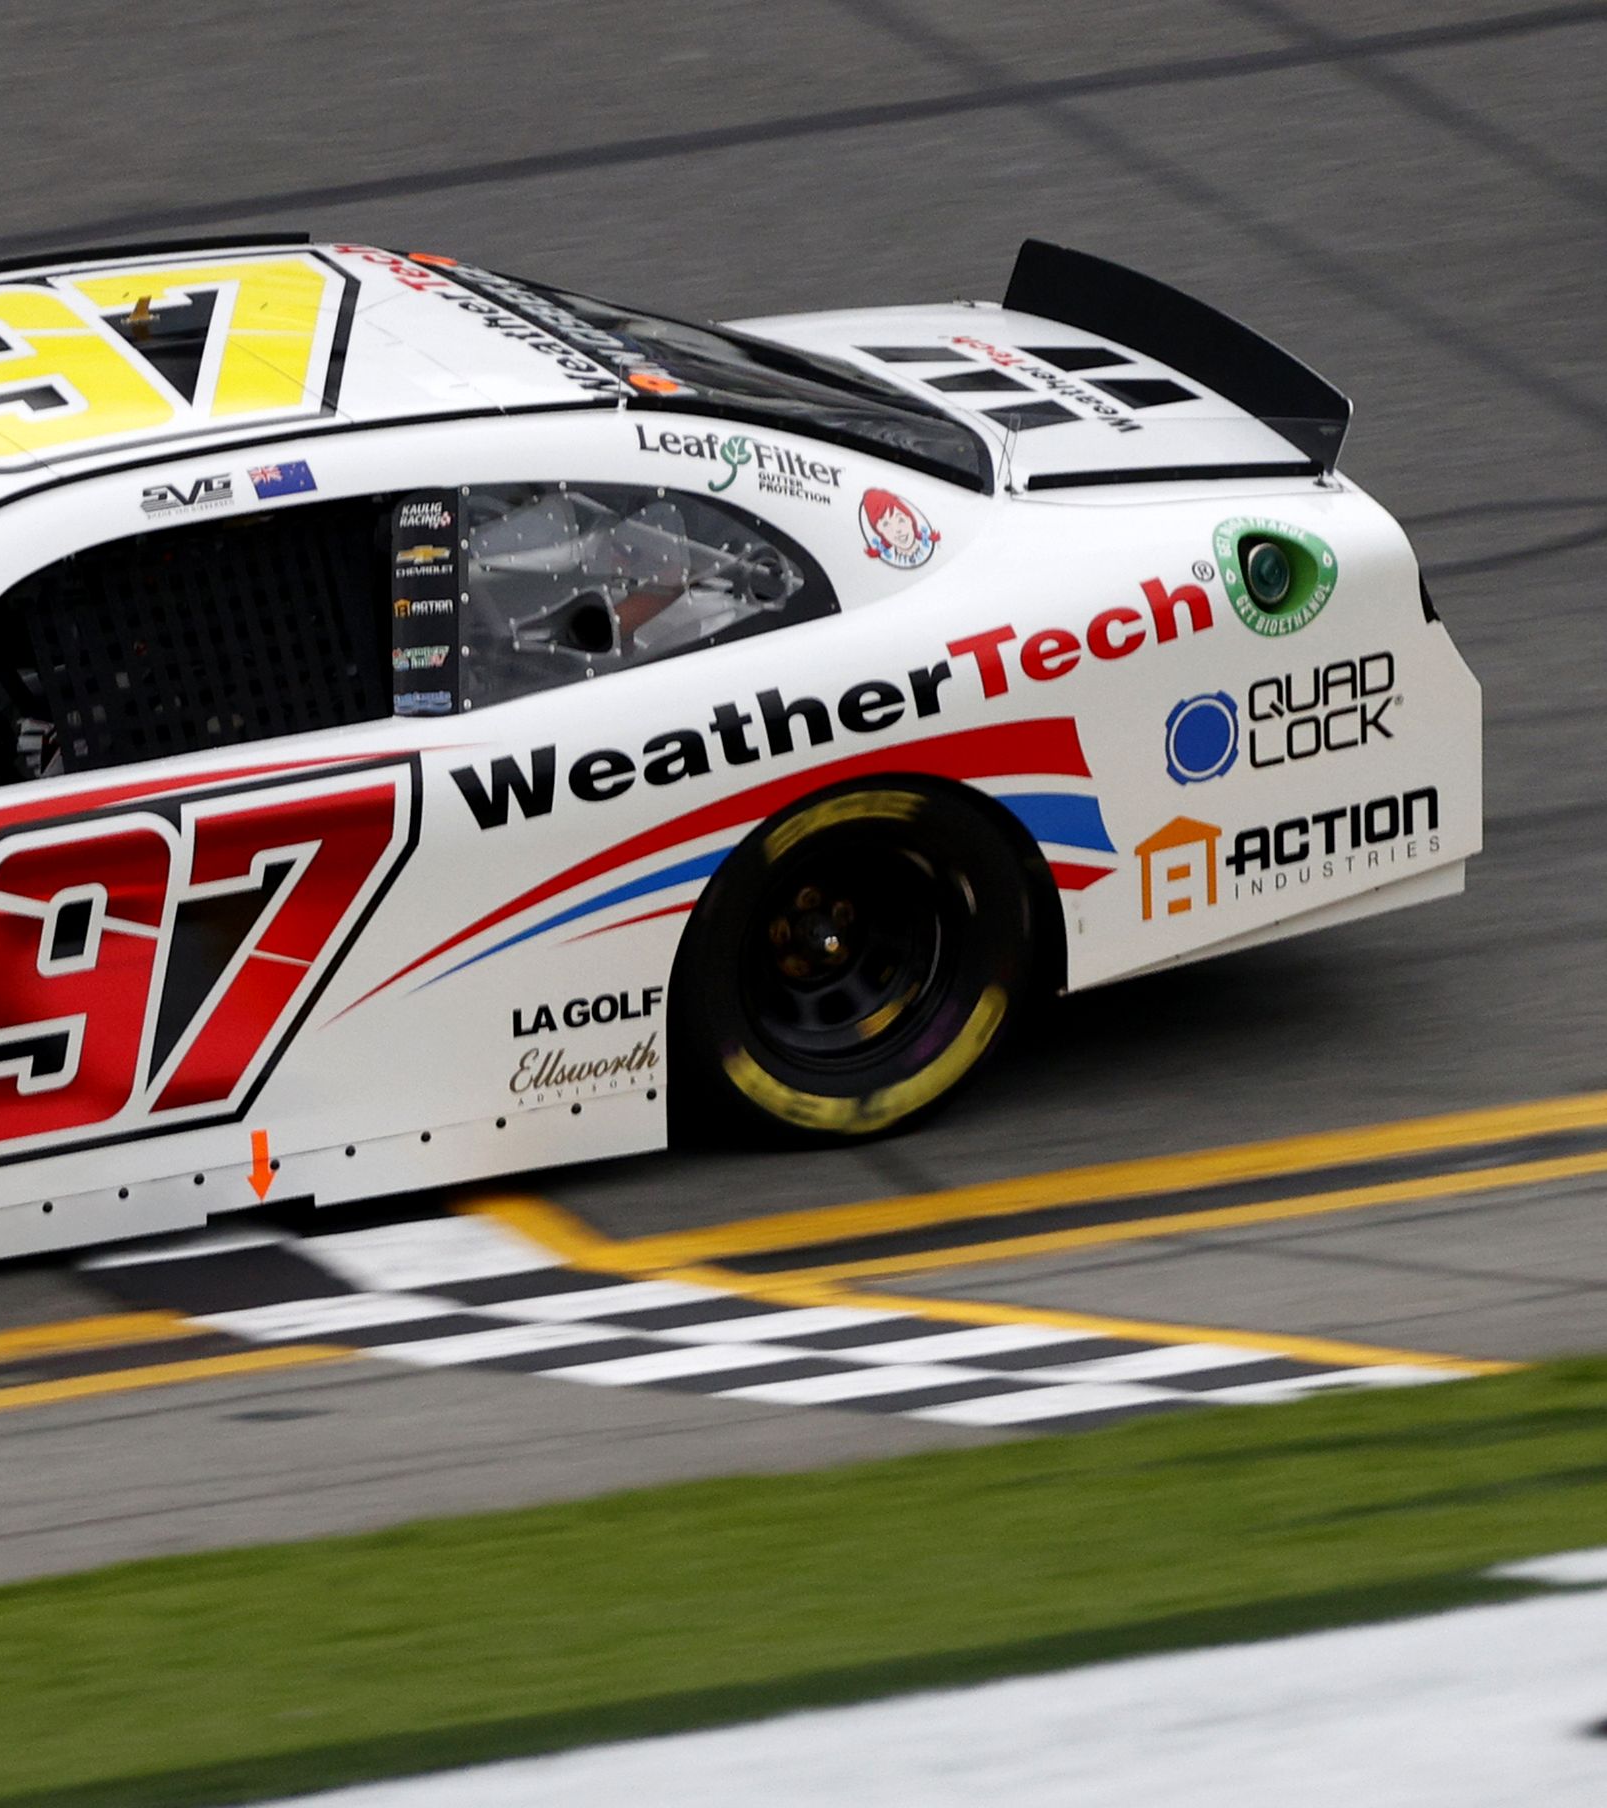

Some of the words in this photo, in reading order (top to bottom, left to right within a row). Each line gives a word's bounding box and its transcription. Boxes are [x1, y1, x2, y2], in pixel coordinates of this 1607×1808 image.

[758, 471, 803, 488] GUTTER
[758, 481, 831, 505] PROTECTION
[399, 512, 442, 529] RACING
[402, 501, 442, 516] KAULIG
[1236, 594, 1258, 623] GET
[1255, 584, 1331, 635] BIOETHANOL
[448, 577, 1214, 831] WeatherTech
[1248, 651, 1394, 722] QUAD
[1248, 697, 1394, 769] LOCK
[1225, 785, 1439, 877] ACTION
[1234, 836, 1441, 900] INDUSTRIES
[513, 1004, 558, 1038] LA
[563, 986, 663, 1028] GOLF
[509, 1031, 660, 1094] Ellsworth
[518, 1073, 655, 1106] ADVISORS
